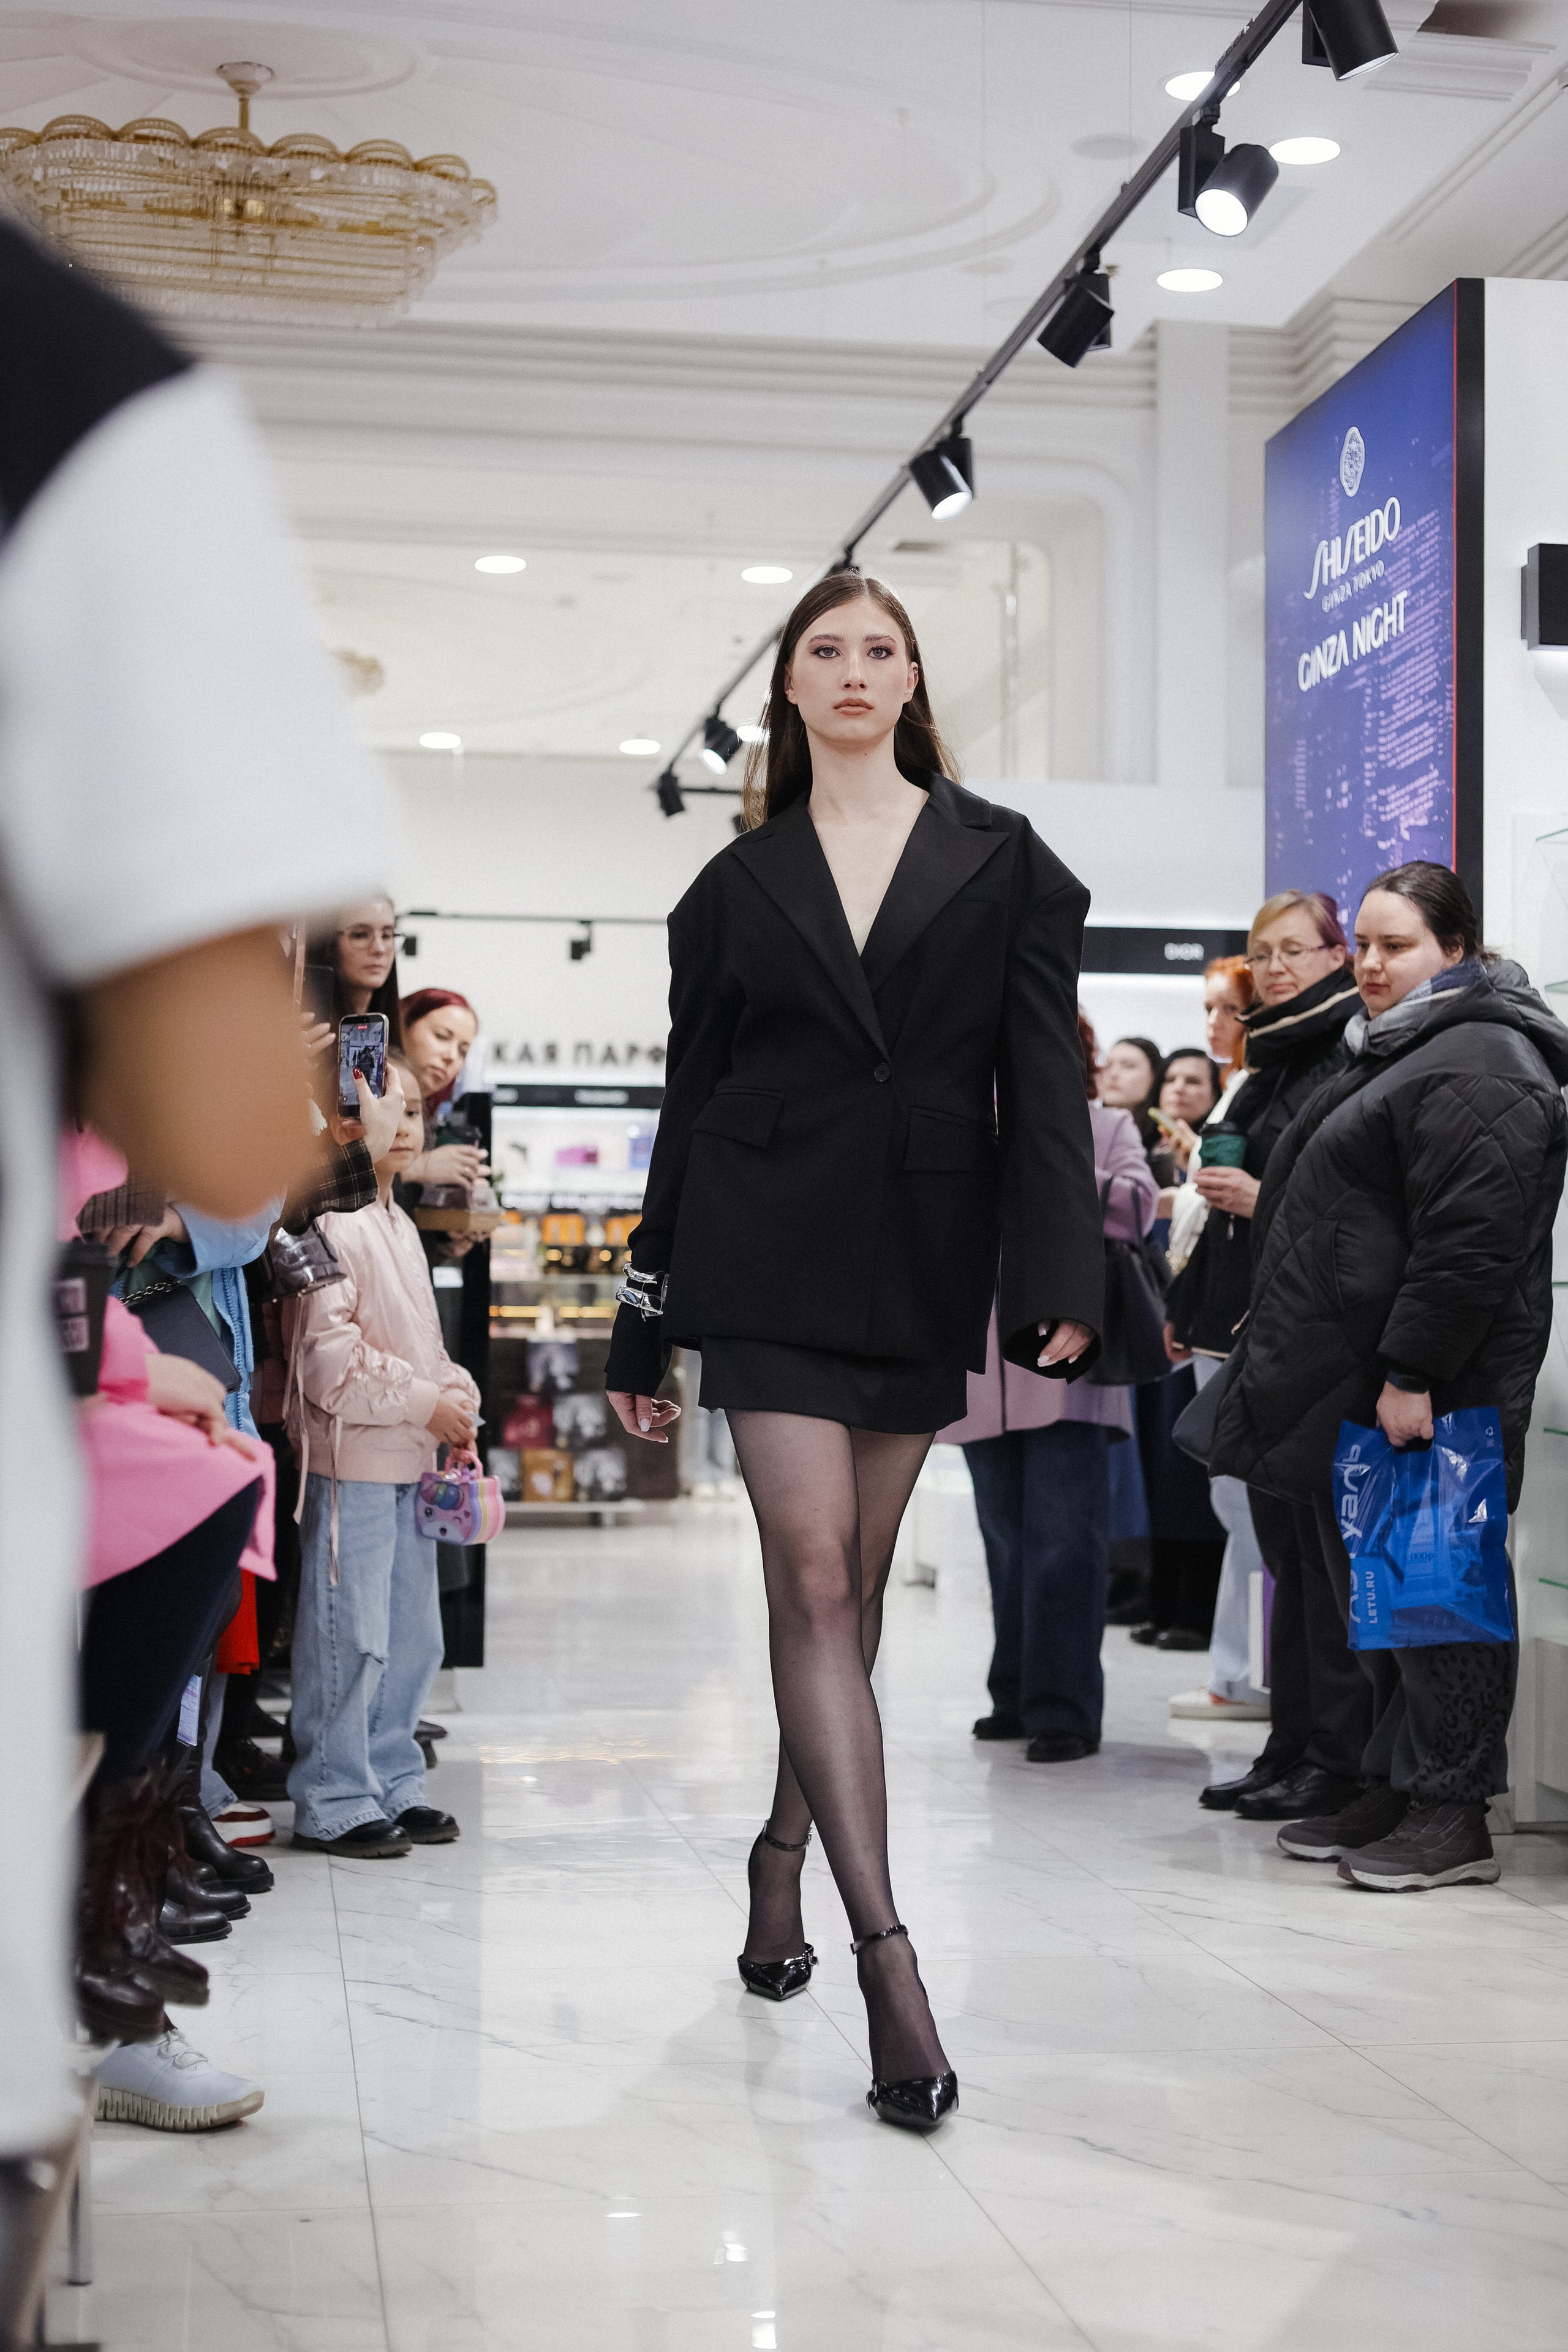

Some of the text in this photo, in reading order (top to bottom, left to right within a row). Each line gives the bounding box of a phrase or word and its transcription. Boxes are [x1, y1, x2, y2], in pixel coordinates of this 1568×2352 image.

[1303, 497, 1401, 600] SHISEIDO
[1322, 560, 1384, 613] GINZA TOKYO
[1298, 590, 1408, 692] GINZA NIGHT
[1365, 1571, 1378, 1624] LETU.RU
